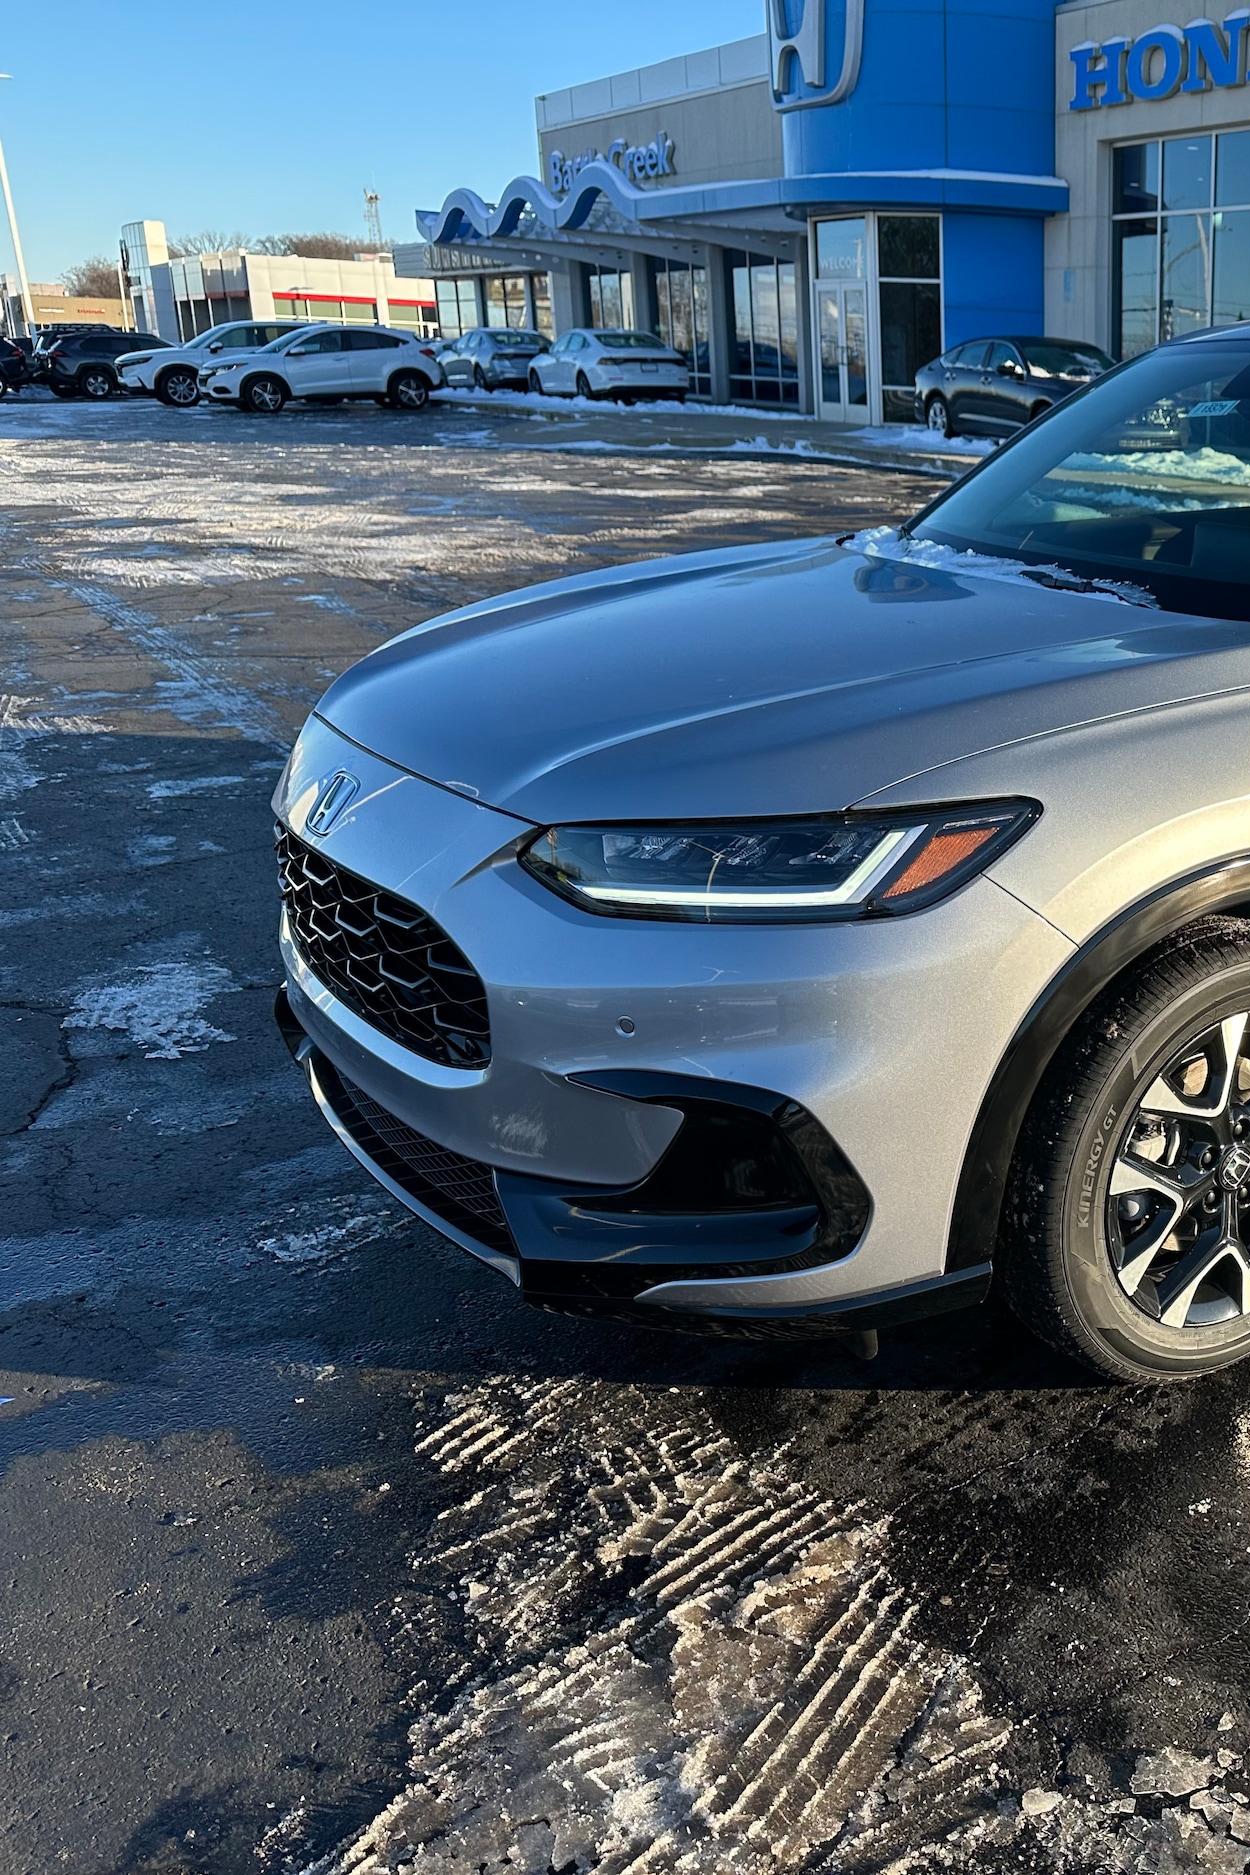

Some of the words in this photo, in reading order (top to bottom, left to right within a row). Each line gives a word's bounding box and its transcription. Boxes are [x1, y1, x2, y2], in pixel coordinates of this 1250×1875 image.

[608, 131, 675, 181] Creek
[1078, 1128, 1105, 1228] KINERGY
[1103, 1104, 1118, 1131] GT
